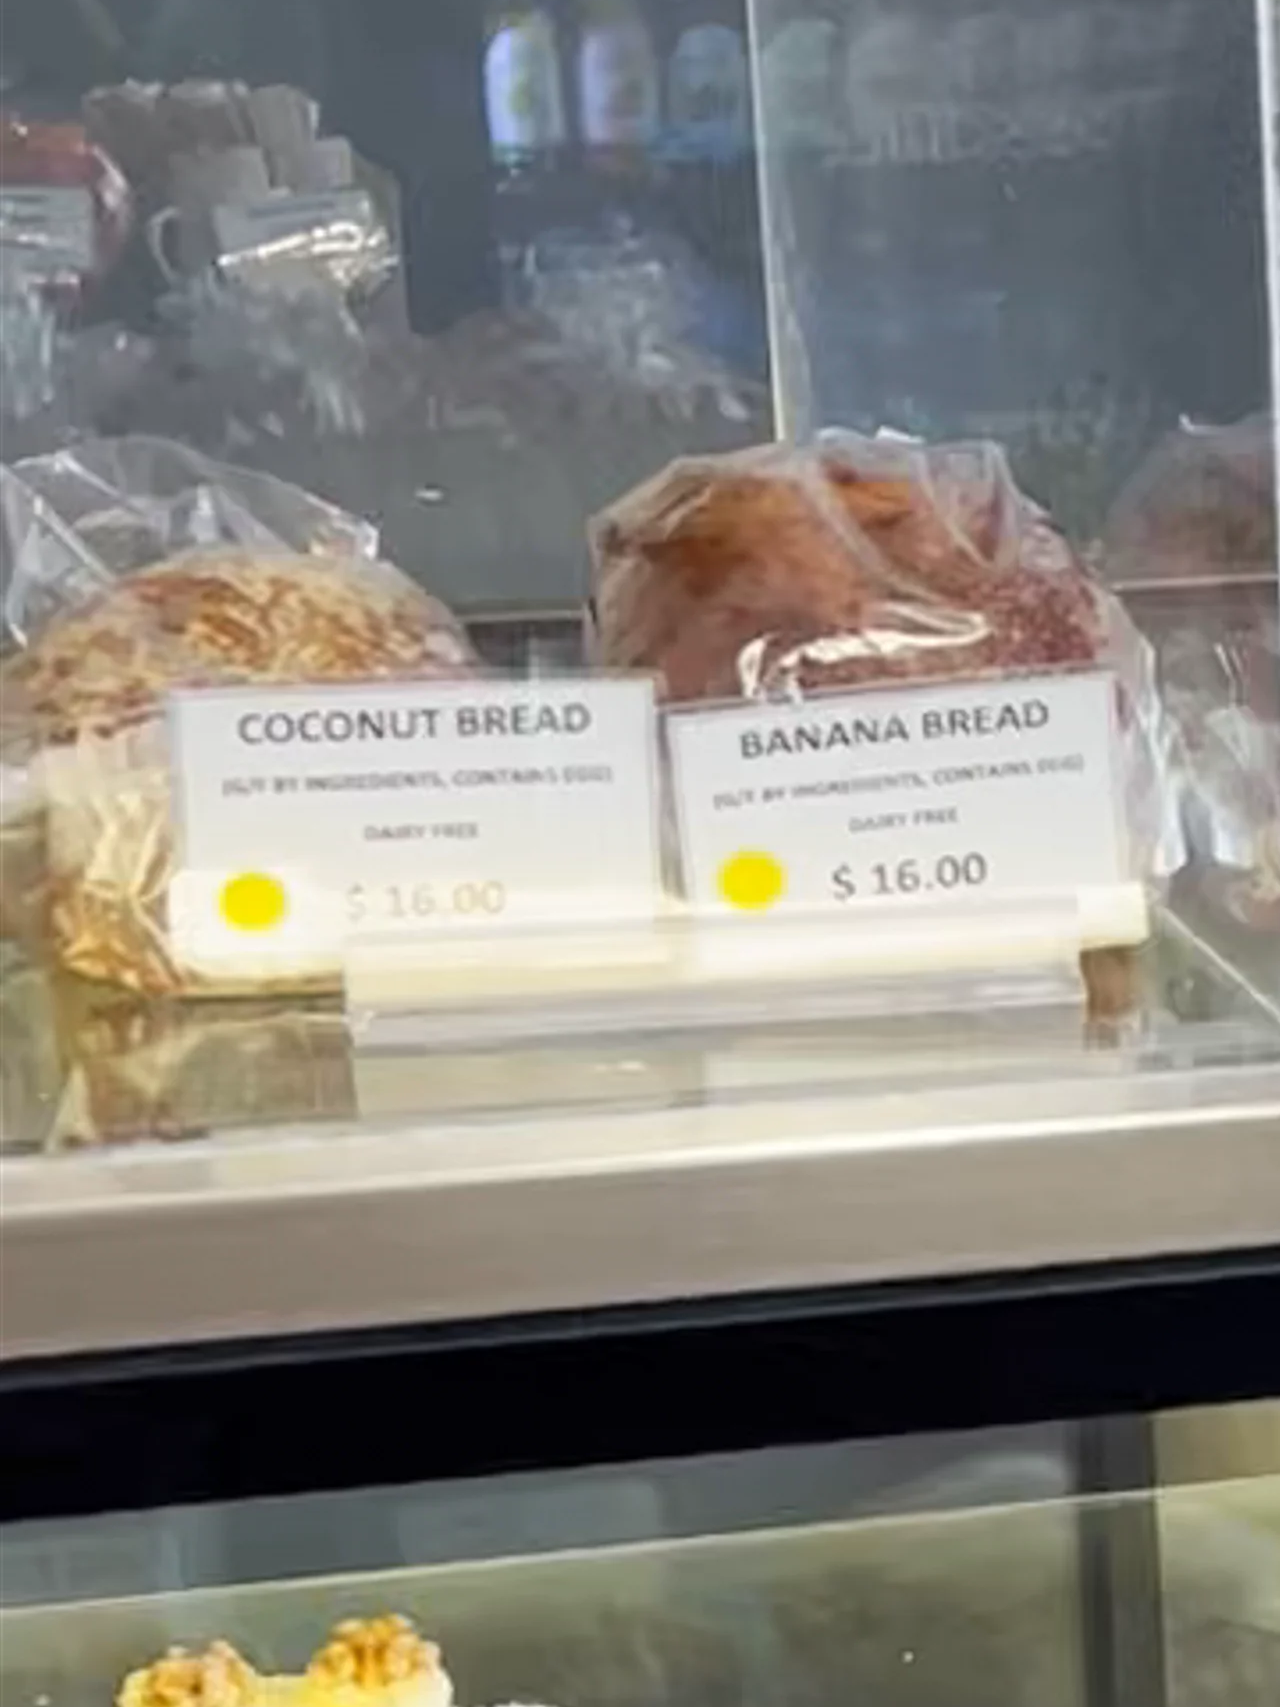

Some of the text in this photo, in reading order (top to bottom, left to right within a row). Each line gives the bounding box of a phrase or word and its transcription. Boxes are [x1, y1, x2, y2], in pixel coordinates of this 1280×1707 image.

[237, 702, 591, 744] COCONUT BREAD
[740, 699, 1049, 760] BANANA BREAD
[364, 822, 479, 842] DAIRY FREE
[848, 807, 959, 834] DAIRY FREE
[831, 852, 988, 902] $ 16.00
[346, 880, 506, 921] $ 16.00
